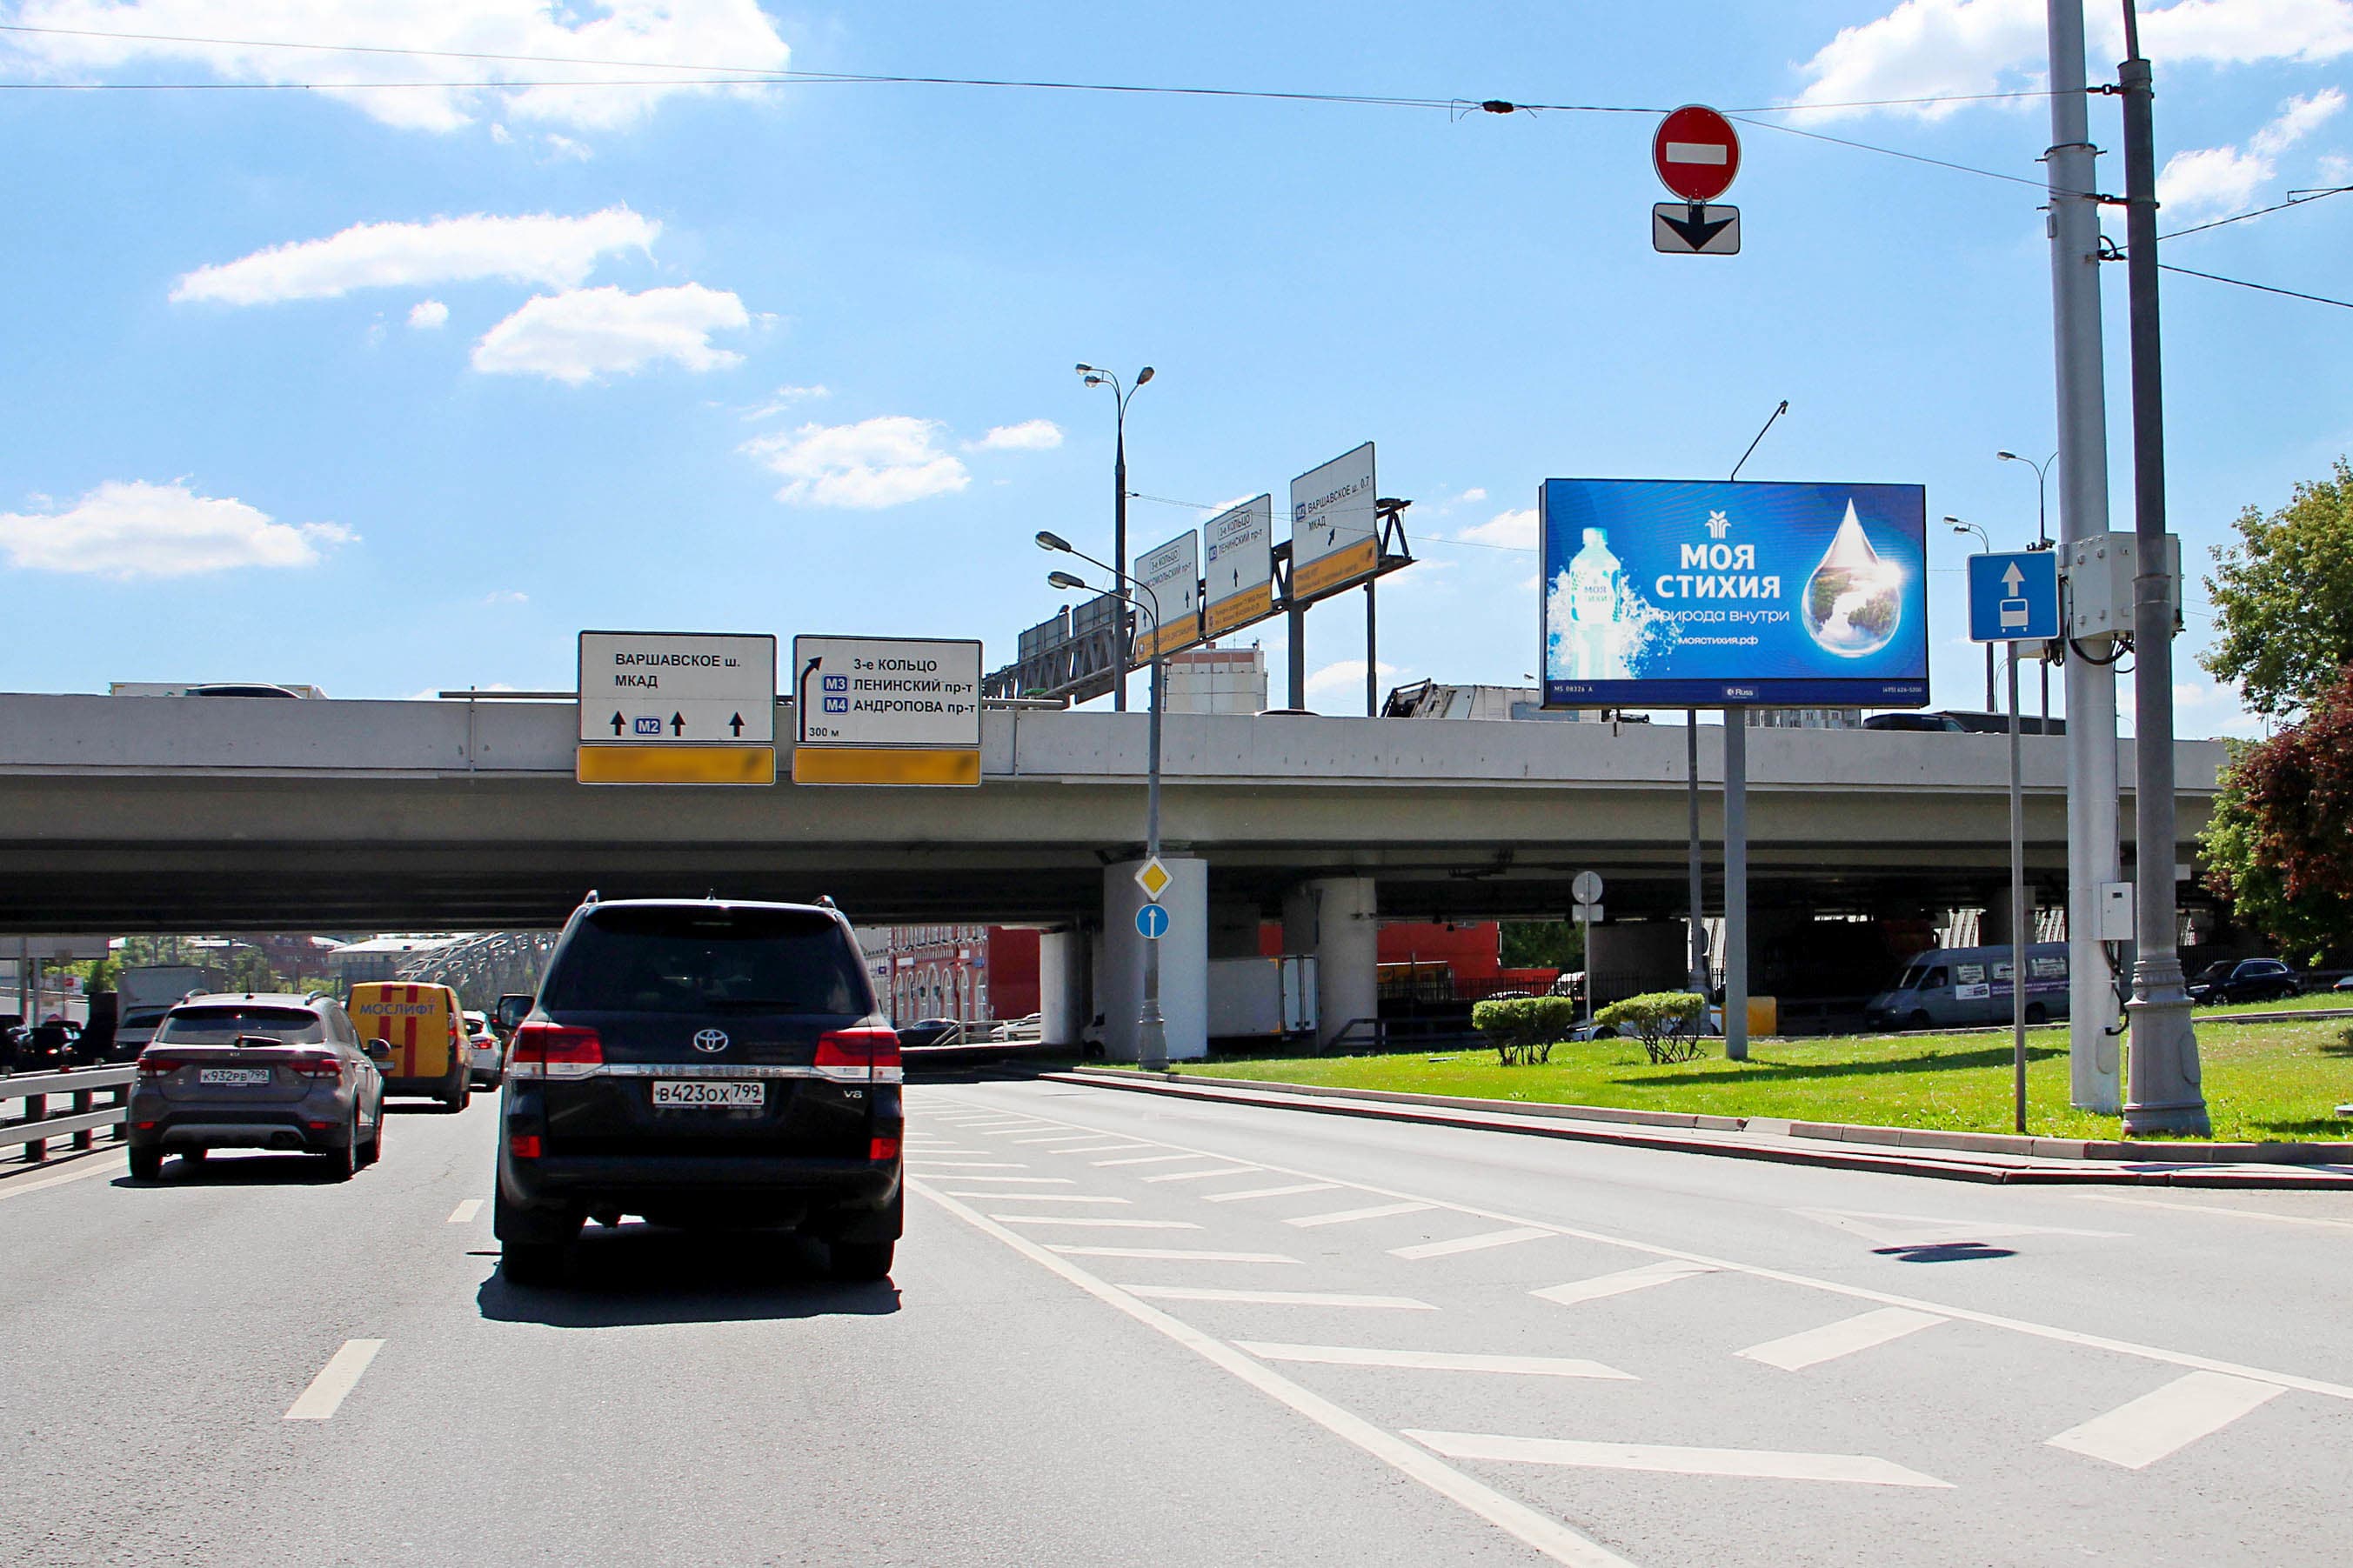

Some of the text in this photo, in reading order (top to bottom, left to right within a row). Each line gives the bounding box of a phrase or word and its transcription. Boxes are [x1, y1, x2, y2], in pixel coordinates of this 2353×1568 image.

[1307, 484, 1350, 513] ВАРШАВСКОЕ
[1308, 516, 1327, 531] МКАД
[1681, 544, 1755, 570] МОЯ
[1655, 575, 1781, 598] СТИХИЯ
[1651, 611, 1790, 624] рирода внутри
[1679, 636, 1759, 646] моястихия.рф
[615, 654, 740, 667] ВАРШАВСКОЕ ш.
[853, 658, 938, 672] 3-е КОЛЬЦО
[615, 675, 658, 688] МКАД
[853, 678, 941, 692] ЛЕНИНСКИЙ
[946, 684, 973, 695] пр-т
[853, 700, 944, 713] АНДРОПОВА
[947, 704, 976, 716] пр-т
[809, 728, 828, 737] 300
[359, 1003, 435, 1016] МОСЛИФТ
[733, 1084, 760, 1098] 799
[843, 1090, 863, 1098] V8
